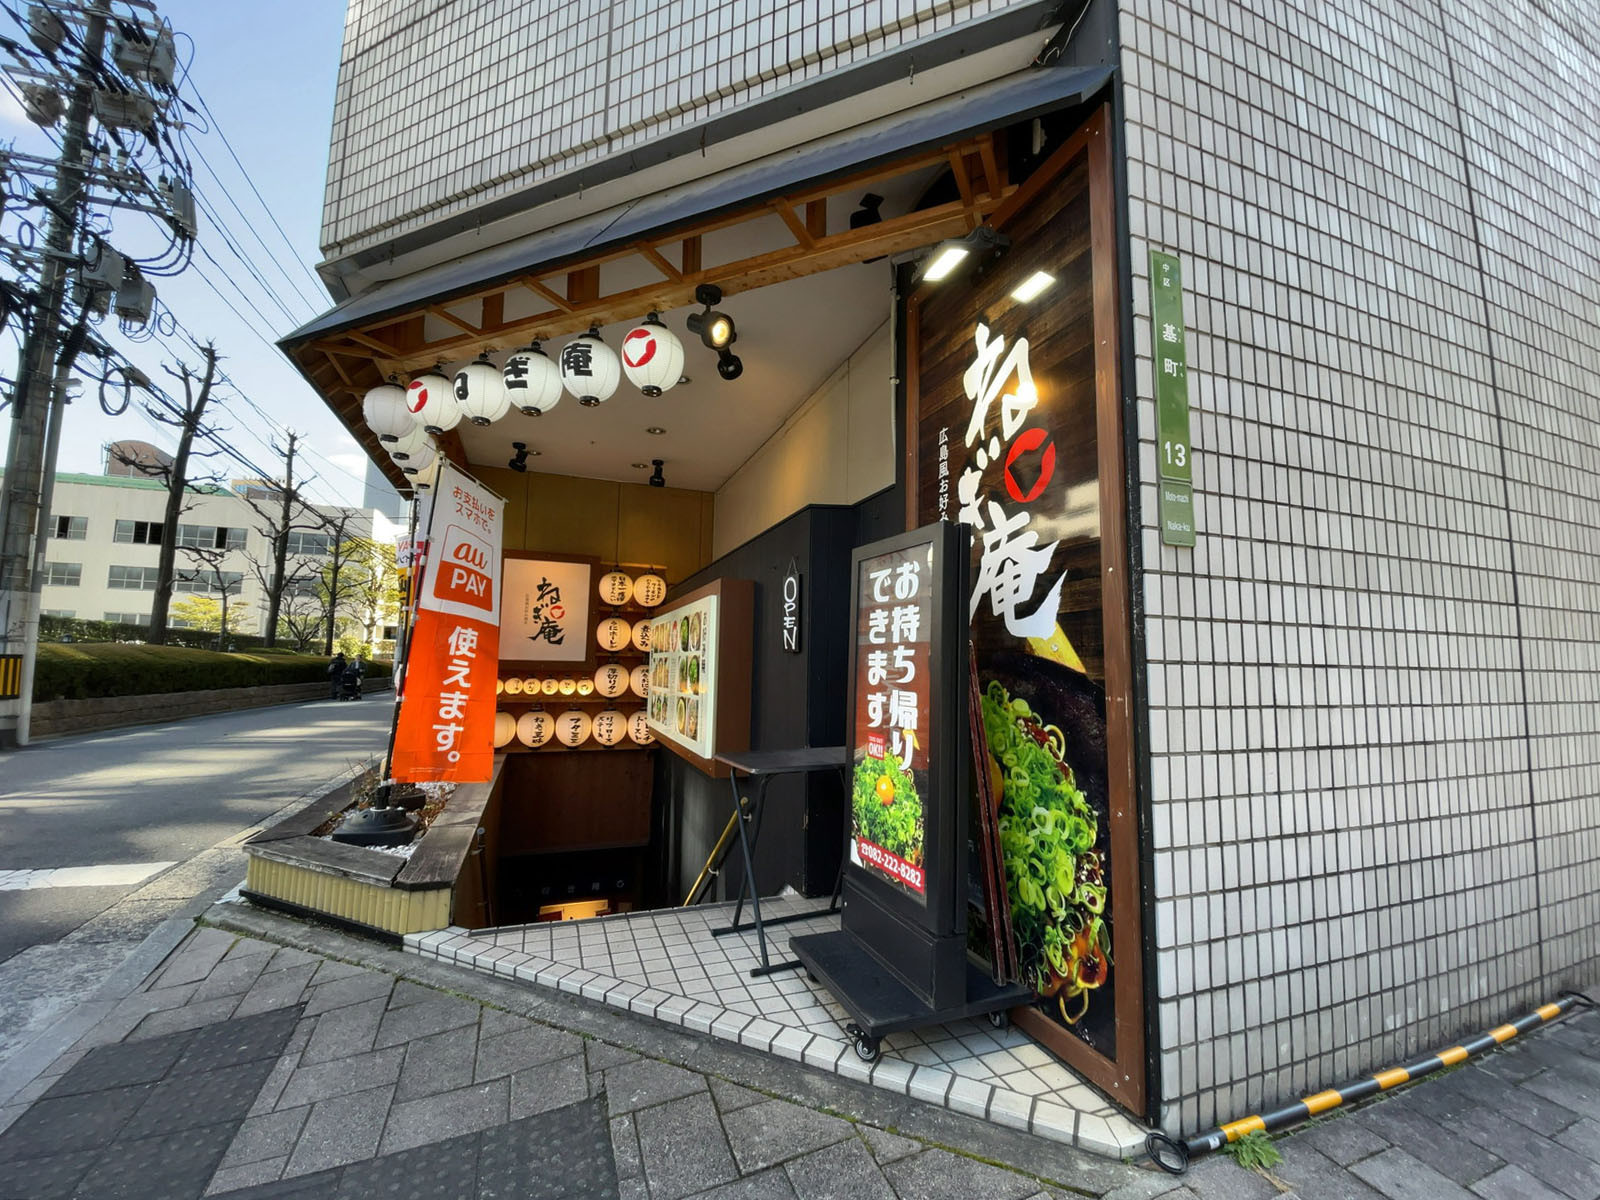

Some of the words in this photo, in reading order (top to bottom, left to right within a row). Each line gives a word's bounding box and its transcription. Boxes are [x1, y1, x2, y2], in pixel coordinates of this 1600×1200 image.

[1162, 262, 1171, 288] 中区
[1162, 322, 1178, 377] 基町
[1164, 440, 1186, 467] 13
[452, 485, 496, 521] お支払いを
[1167, 520, 1191, 532] Naka-ku
[452, 542, 489, 570] au
[450, 571, 487, 597] PAY
[528, 576, 566, 646] ねぎ庵
[783, 576, 797, 650] OPEN
[867, 567, 892, 727] できます
[889, 560, 921, 771] お持ち帰り
[432, 625, 479, 763] 使えます。
[868, 846, 922, 888] 082-222-8282
